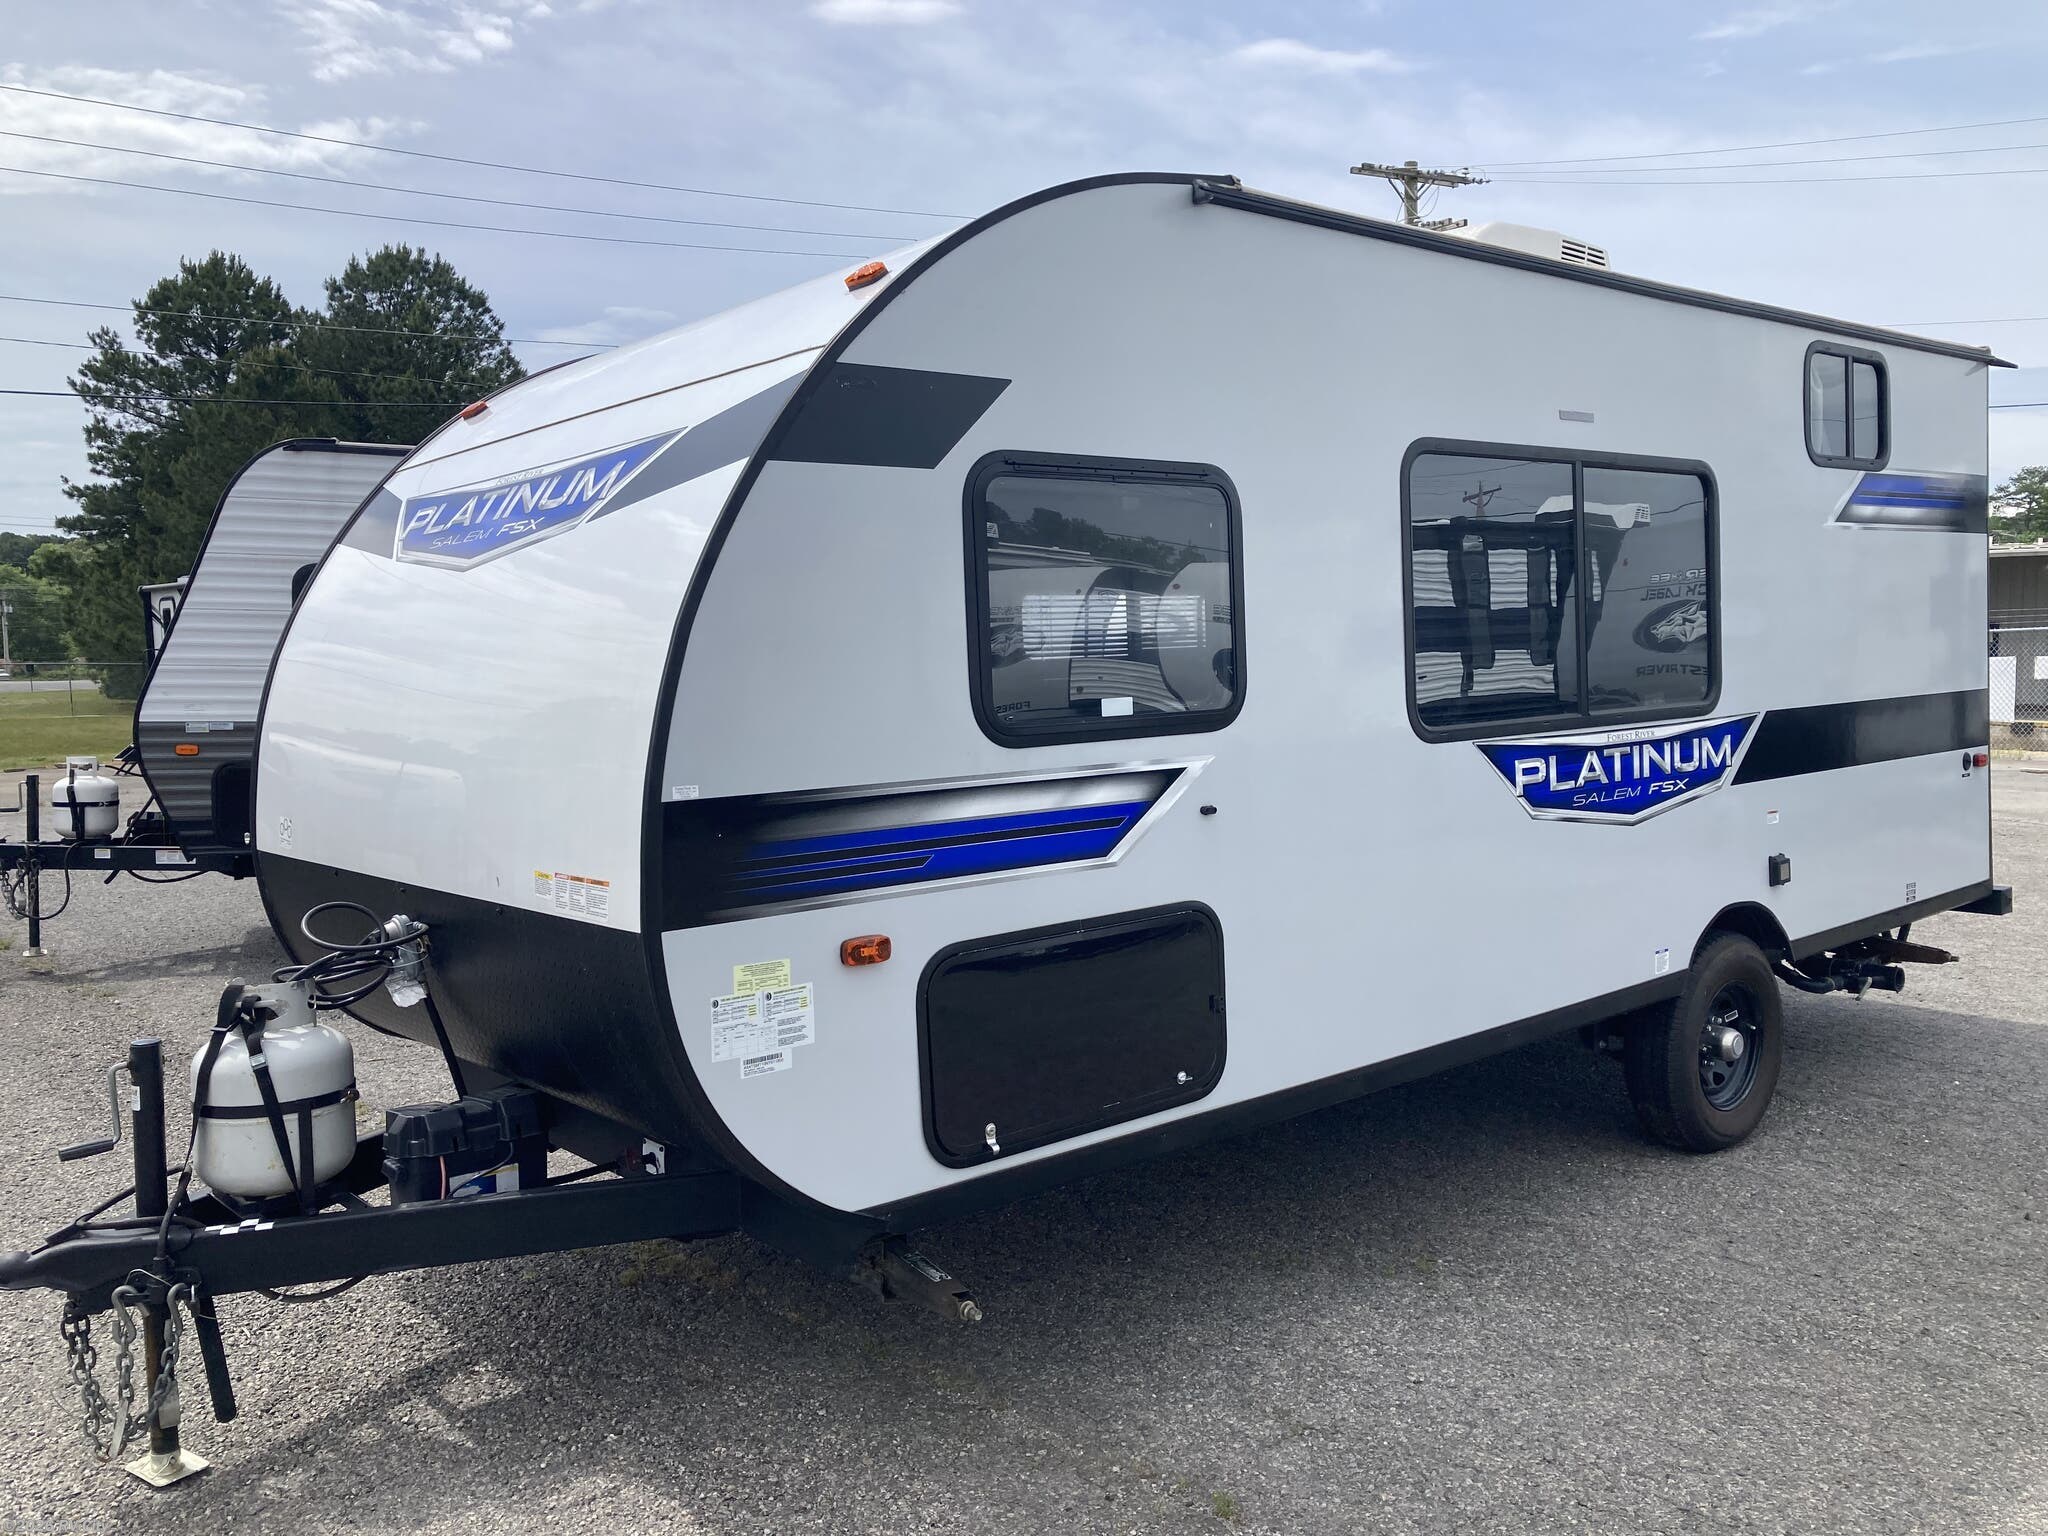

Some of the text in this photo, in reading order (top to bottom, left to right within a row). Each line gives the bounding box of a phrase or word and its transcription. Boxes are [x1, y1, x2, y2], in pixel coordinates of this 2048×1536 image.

[402, 459, 627, 538] PLATINUM
[431, 516, 546, 550] SALEM FSX
[1607, 730, 1656, 742] FOREST RIVER
[1514, 734, 1732, 797] PLATINUM
[1572, 778, 1689, 807] SALEM FSX
